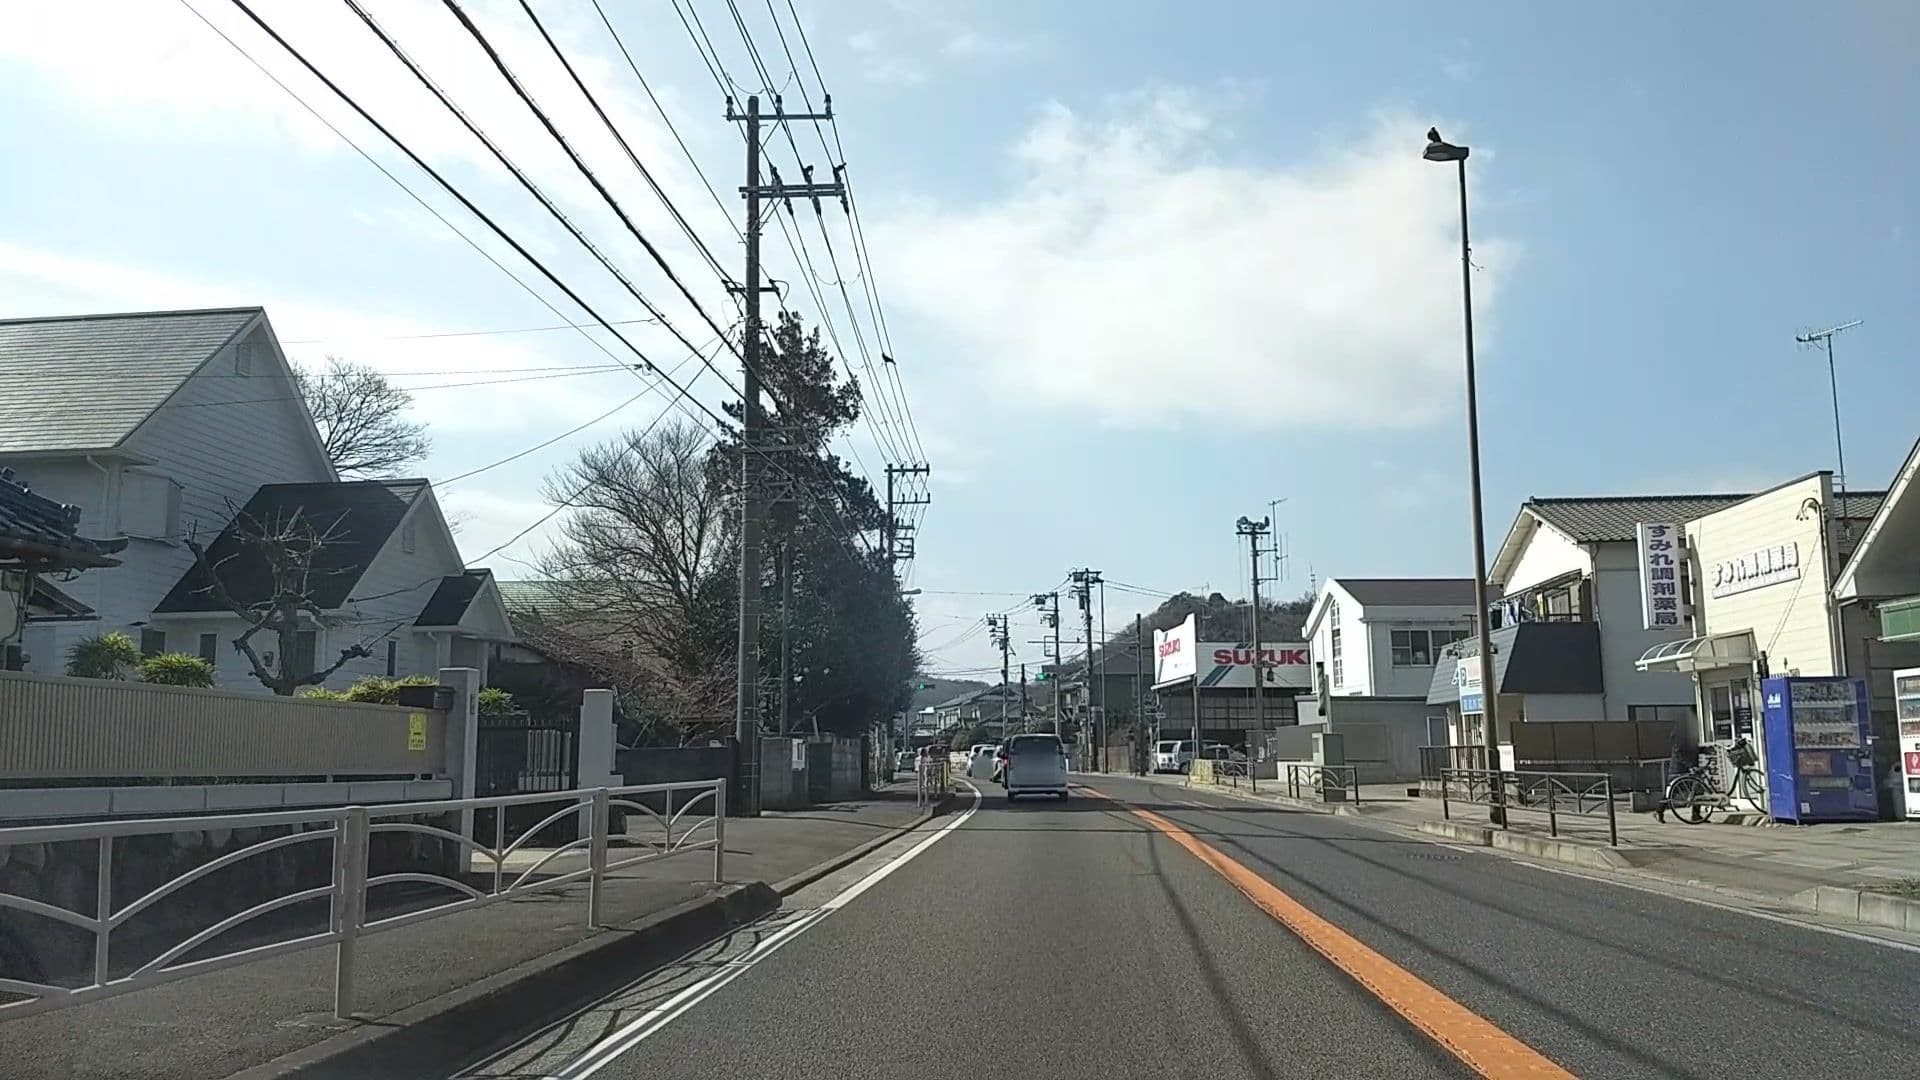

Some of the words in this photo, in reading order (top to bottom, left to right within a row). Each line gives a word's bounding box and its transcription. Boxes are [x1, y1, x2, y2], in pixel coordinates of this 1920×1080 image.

[1647, 525, 1678, 625] すみれ調剤薬局
